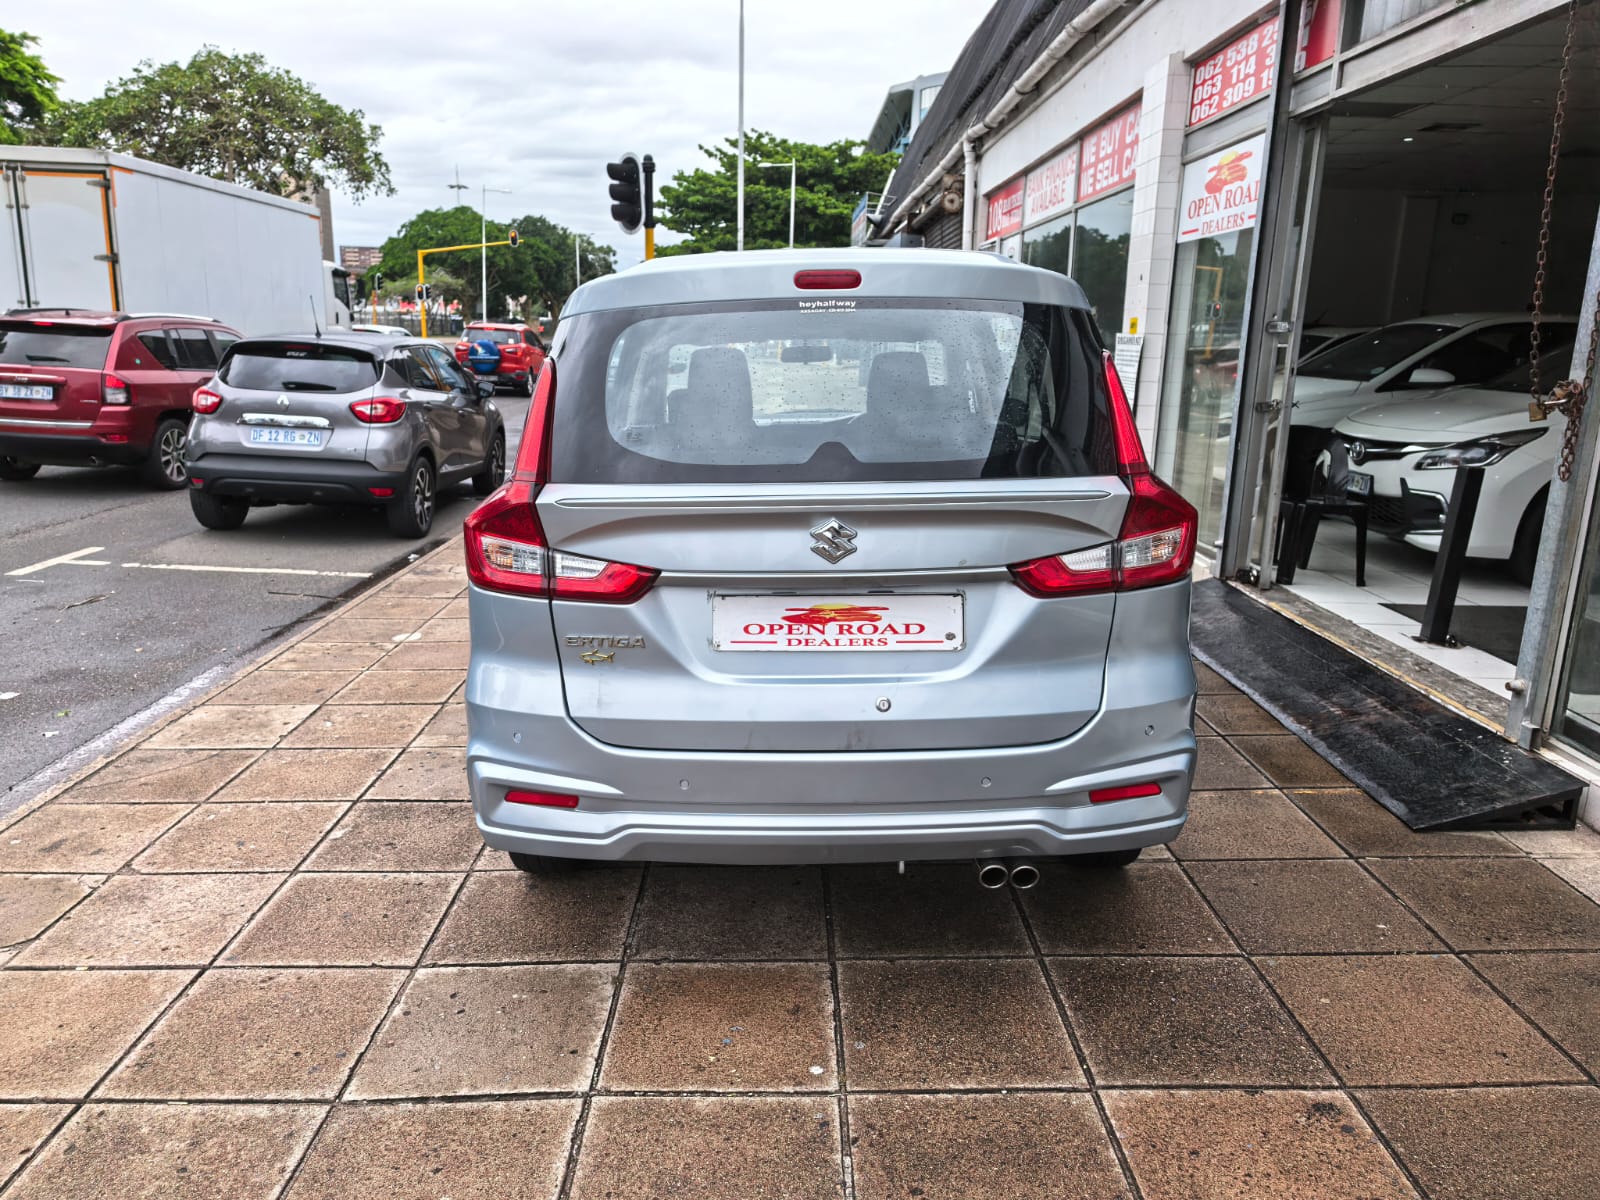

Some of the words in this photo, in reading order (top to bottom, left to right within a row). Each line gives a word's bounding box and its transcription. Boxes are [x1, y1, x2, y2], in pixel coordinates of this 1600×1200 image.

[1195, 54, 1224, 85] 062
[1226, 33, 1259, 67] 538
[1193, 74, 1222, 104] 063
[1230, 55, 1256, 84] 114
[1191, 95, 1219, 123] 062
[1222, 76, 1256, 107] 309
[1083, 135, 1097, 167] WE
[1099, 120, 1122, 158] BUY
[1080, 167, 1095, 197] WE
[1095, 154, 1119, 190] SELL
[1188, 194, 1220, 220] OPEN
[1201, 212, 1245, 235] DEALERS
[799, 300, 856, 308] heyhalfway
[252, 429, 264, 441] DF
[268, 430, 280, 441] 12
[284, 430, 296, 442] RG
[307, 431, 320, 443] ZN
[564, 634, 646, 648] ERTIGA
[743, 623, 826, 636] OPEN
[838, 623, 926, 636] ROAD
[787, 638, 888, 647] DEALERS
